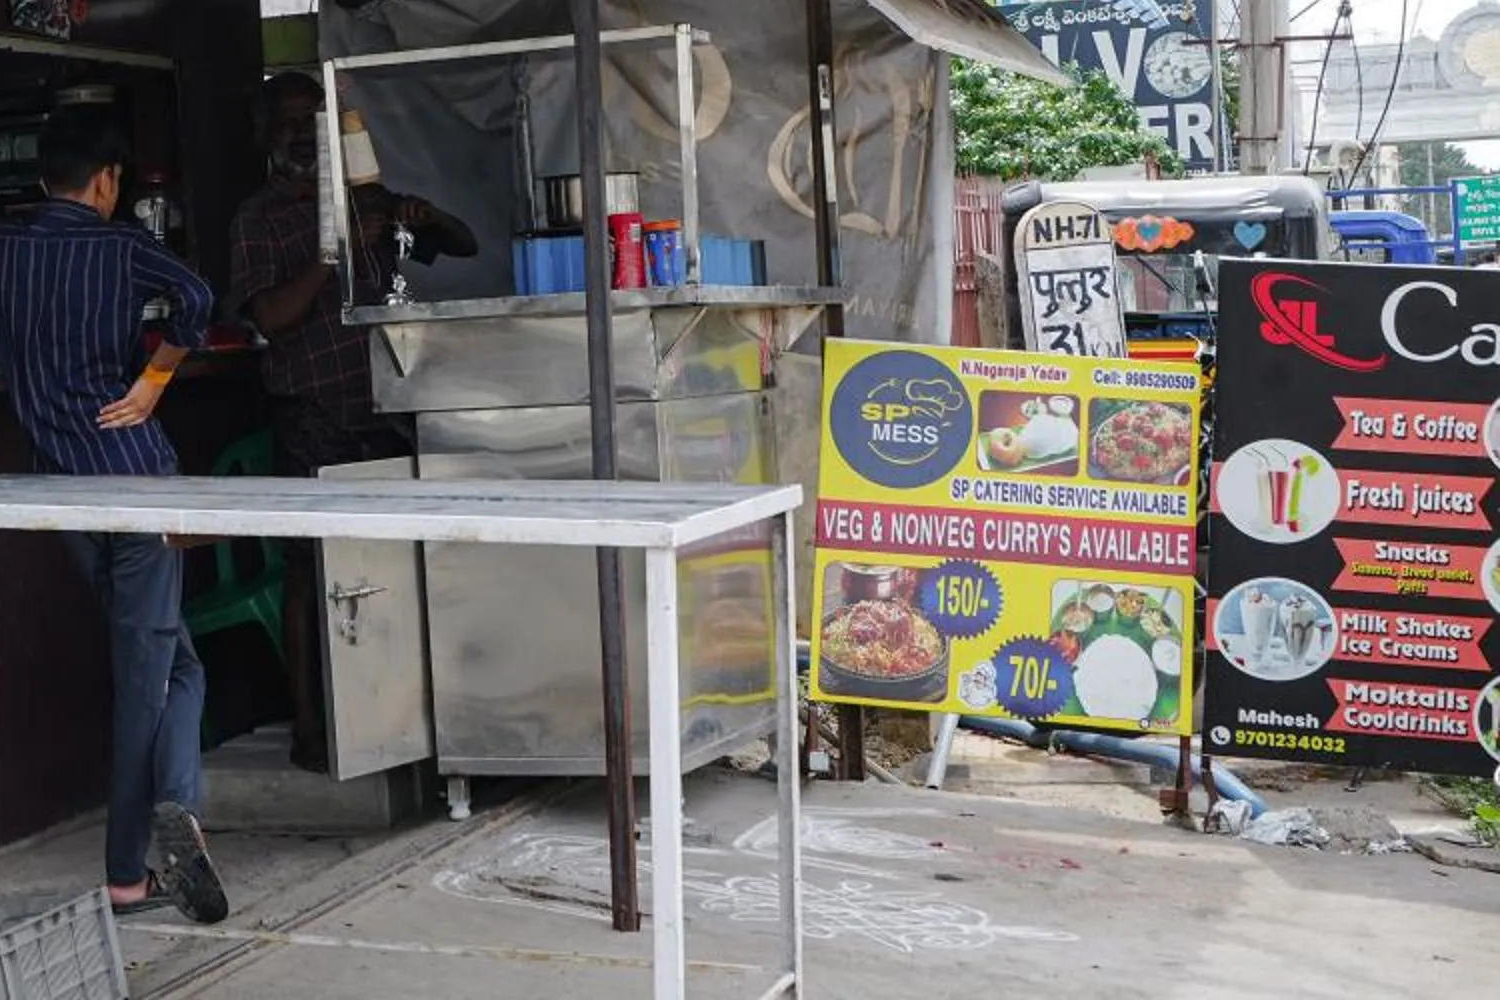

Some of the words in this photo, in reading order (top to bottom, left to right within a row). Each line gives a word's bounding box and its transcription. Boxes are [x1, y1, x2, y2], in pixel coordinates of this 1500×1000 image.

[1041, 322, 1087, 356] 31
[861, 402, 910, 421] SP
[872, 424, 940, 444] MESS
[1350, 410, 1385, 437] Tea
[1392, 413, 1407, 438] &
[1413, 414, 1478, 441] Coffee
[952, 479, 970, 499] SP
[975, 481, 1043, 505] CATERING
[1047, 486, 1107, 509] SERVICE
[1111, 491, 1187, 515] AVAILABLE
[1347, 479, 1405, 509] Fresh
[1412, 483, 1476, 517] juices
[823, 507, 863, 541] VEG
[871, 511, 883, 542] &
[890, 512, 975, 549] NONVEG
[983, 519, 1071, 557] CURRY'S
[1078, 526, 1189, 565] AVAILABLE
[1375, 542, 1450, 564] Snacks
[936, 576, 989, 617] 150/-
[1342, 613, 1389, 634] Milk
[1396, 617, 1473, 639] Shakes
[1341, 636, 1372, 655] Ice
[1380, 638, 1459, 662] Creams
[1009, 655, 1057, 699] 70/-
[1346, 683, 1469, 711] Moktails
[1238, 708, 1320, 729] Mahesh
[1345, 708, 1467, 735] Cooldrinks
[1235, 730, 1346, 753] 9701234032
